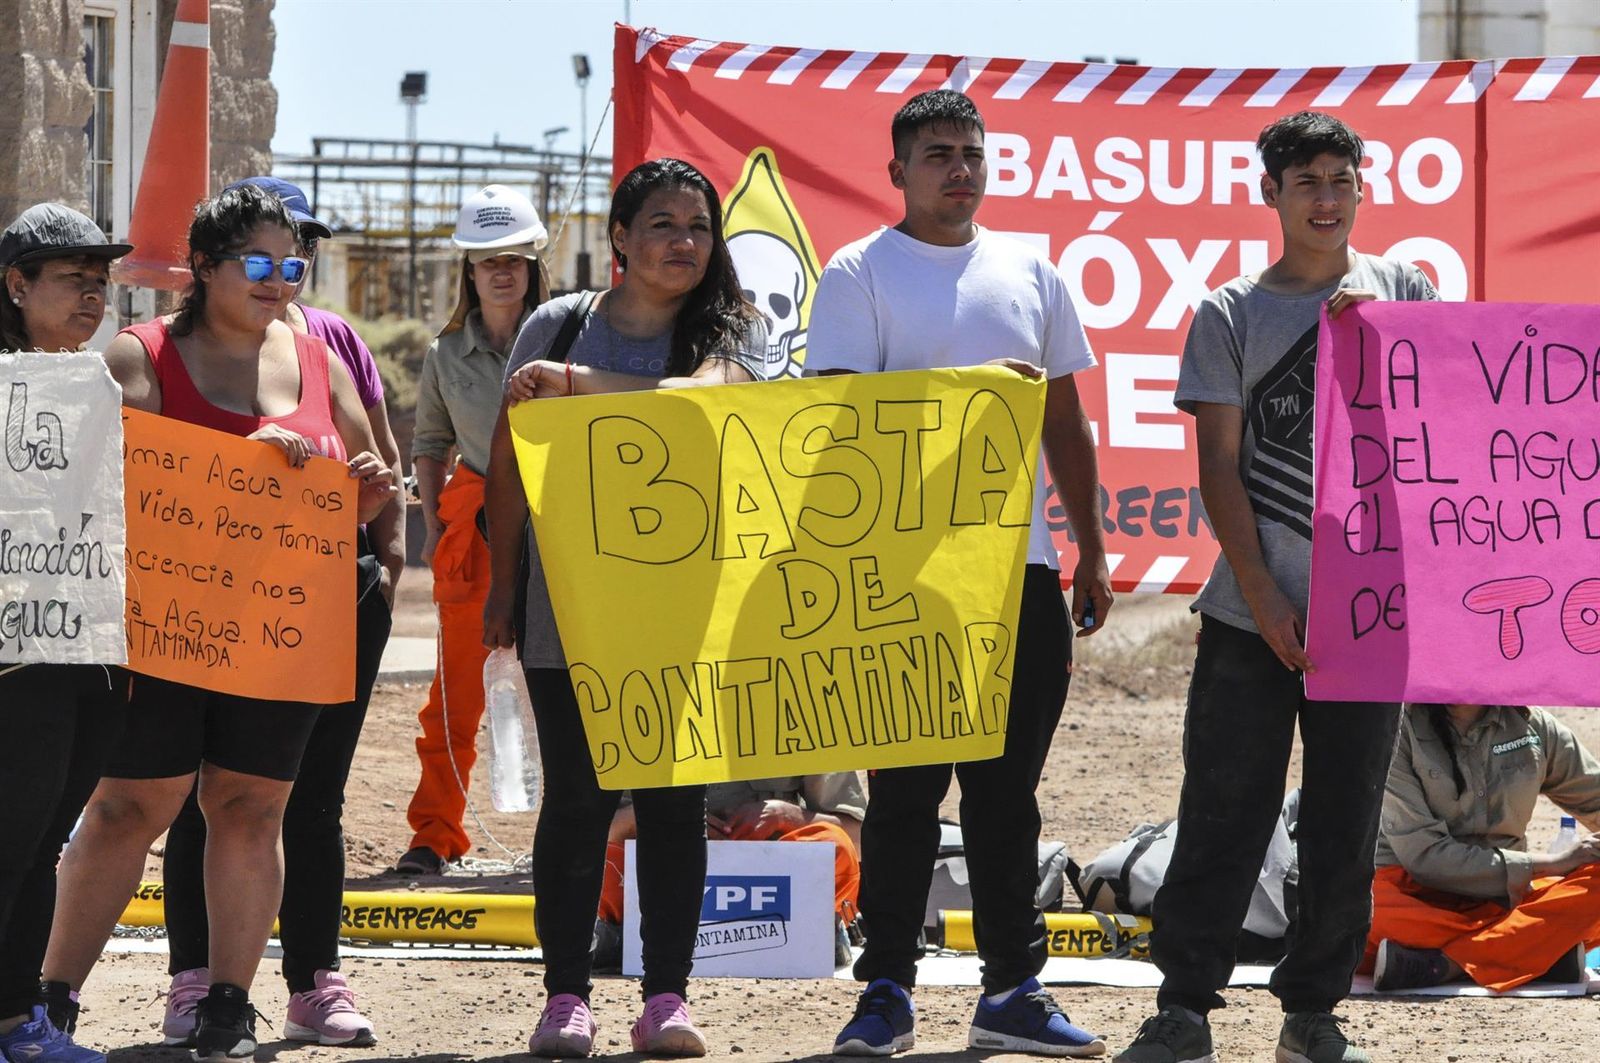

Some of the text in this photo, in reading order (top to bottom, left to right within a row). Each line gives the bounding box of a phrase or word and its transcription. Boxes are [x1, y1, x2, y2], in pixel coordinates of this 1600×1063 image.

[983, 132, 1463, 206] BASURRO
[1350, 327, 1420, 409] LA
[588, 389, 1034, 566] BASTA
[1350, 422, 1459, 489] DEL
[301, 488, 343, 512] nos
[1344, 493, 1398, 555] EL
[1429, 495, 1561, 552] AGUA
[214, 505, 262, 540] Pero
[274, 523, 350, 558] Tomar
[252, 580, 306, 605] nos
[778, 556, 919, 640] DE
[262, 617, 302, 649] NO
[703, 886, 778, 911] PF
